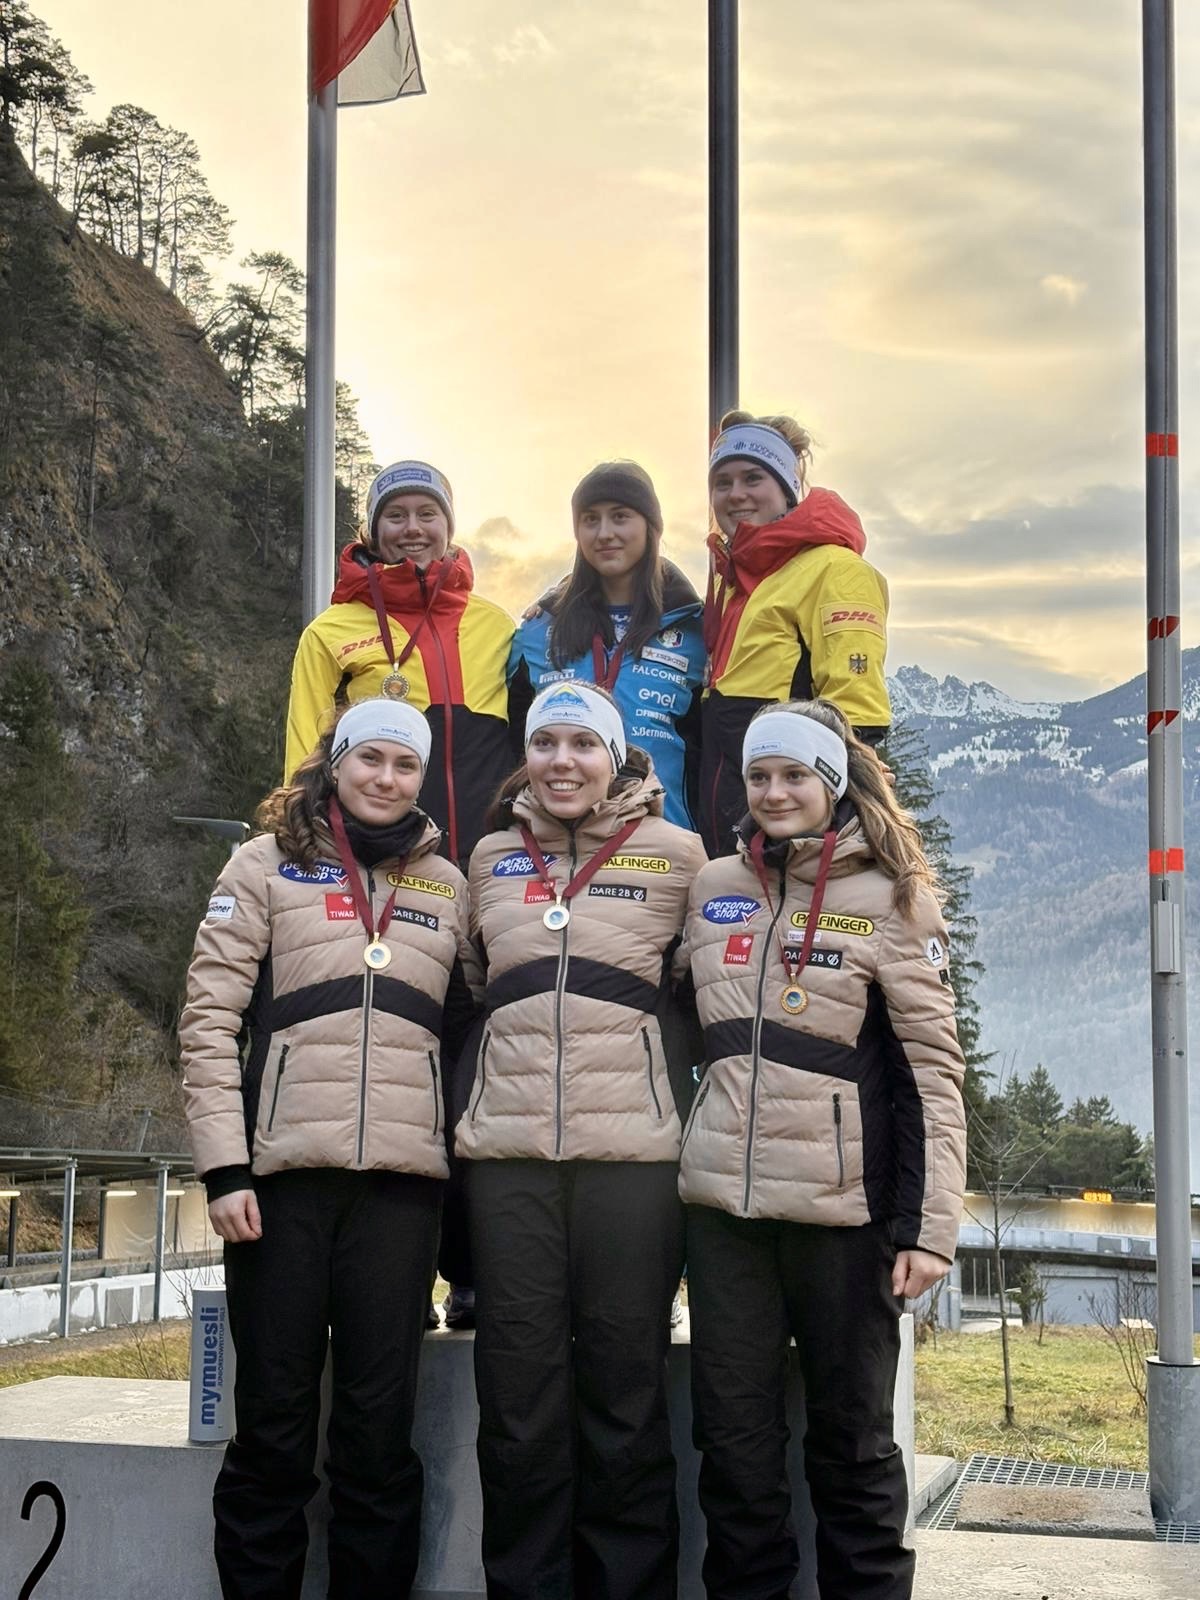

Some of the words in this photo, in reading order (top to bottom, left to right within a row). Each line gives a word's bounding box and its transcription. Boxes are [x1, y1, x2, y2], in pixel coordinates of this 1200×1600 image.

[831, 611, 878, 623] DHL
[639, 688, 676, 708] enel
[504, 863, 534, 875] shop
[603, 857, 666, 871] ALFINGER
[295, 870, 329, 881] shop
[590, 887, 617, 896] DARE
[618, 888, 631, 897] 2B
[706, 901, 757, 912] personal
[414, 913, 426, 923] 2B
[713, 908, 739, 920] shop
[796, 913, 868, 933] PAFINGER
[811, 952, 824, 962] 2B
[200, 1306, 222, 1425] mymuesli
[18, 1480, 66, 1600] 2
